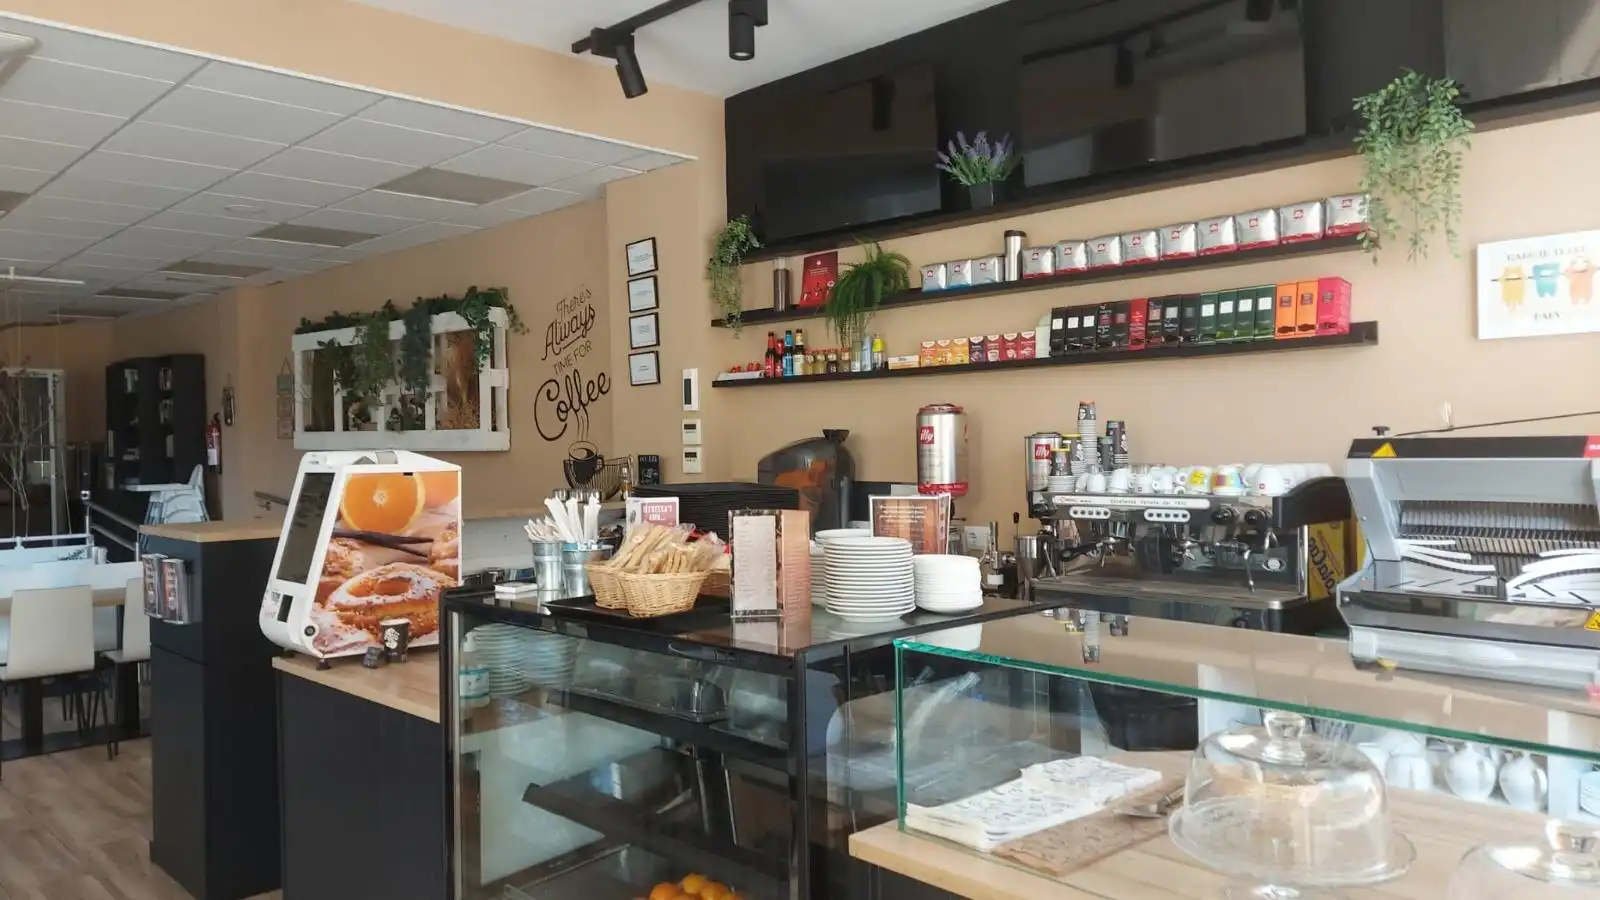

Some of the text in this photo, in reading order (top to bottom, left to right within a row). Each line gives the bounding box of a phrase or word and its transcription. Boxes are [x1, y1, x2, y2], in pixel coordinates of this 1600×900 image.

[556, 284, 592, 321] There's
[541, 303, 595, 360] Always
[552, 340, 592, 375] TIME FOR
[534, 369, 611, 441] Coffee
